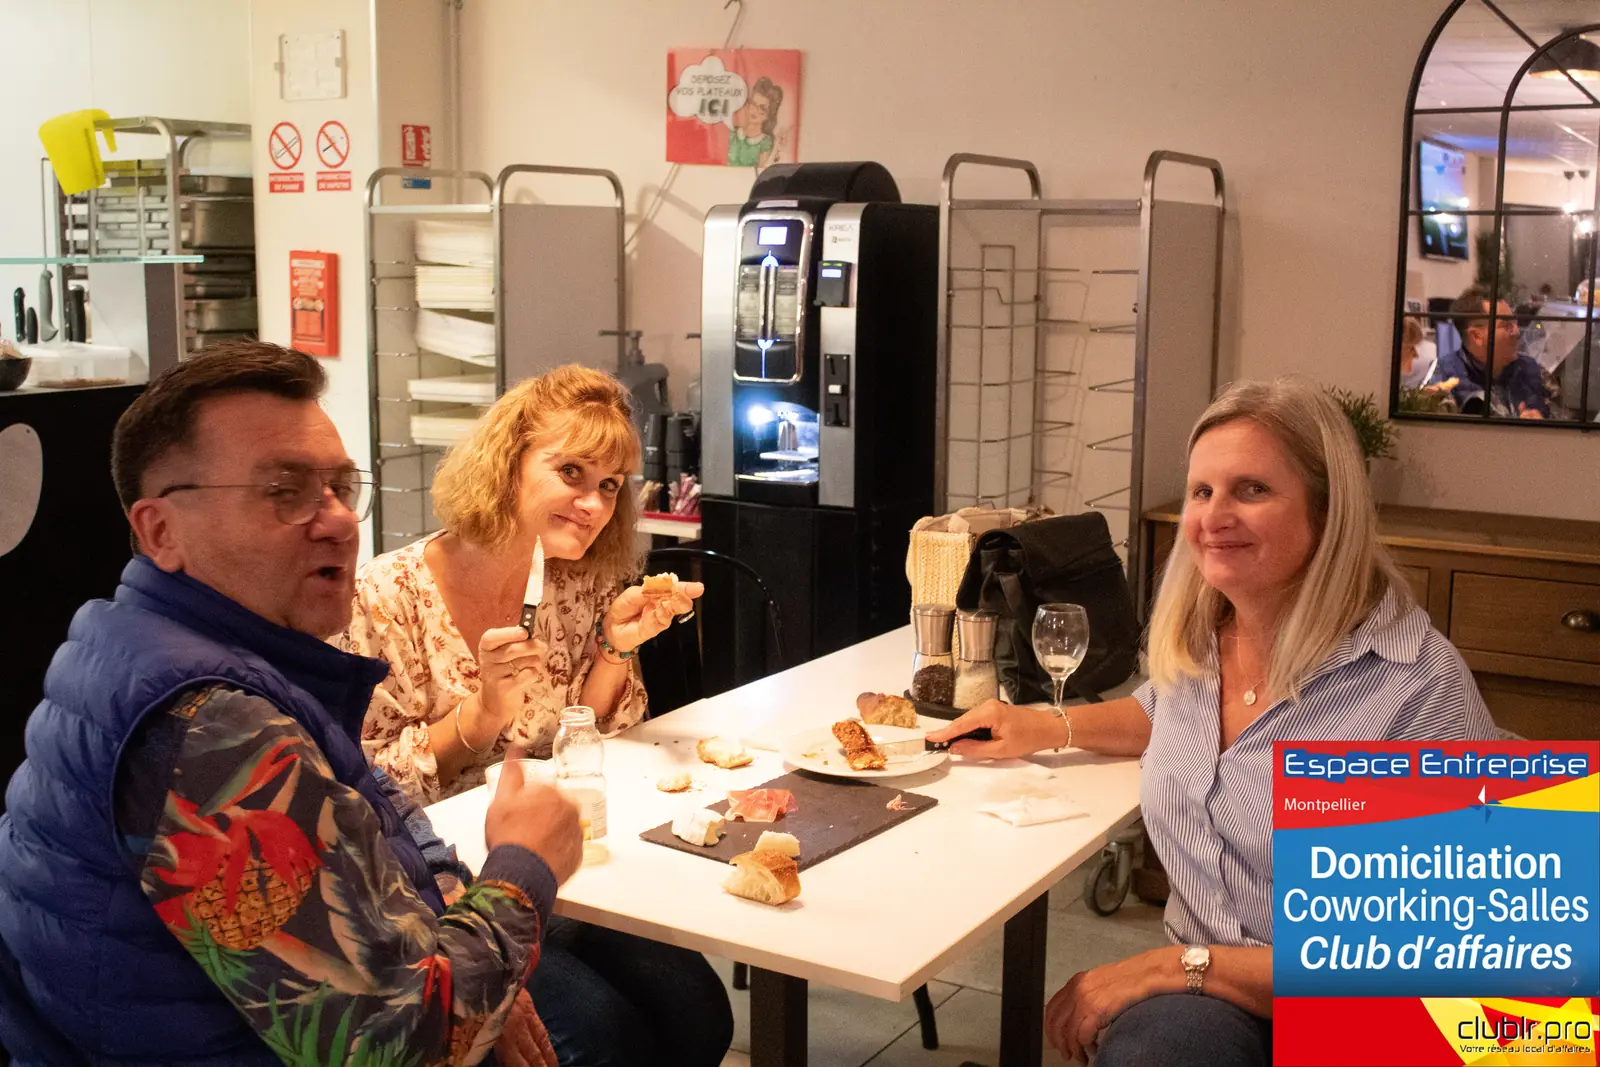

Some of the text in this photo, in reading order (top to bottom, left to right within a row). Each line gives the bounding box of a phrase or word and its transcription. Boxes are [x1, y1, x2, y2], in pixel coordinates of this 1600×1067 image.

[676, 87, 744, 97] VOS PLATEAUX
[699, 98, 730, 117] ICI
